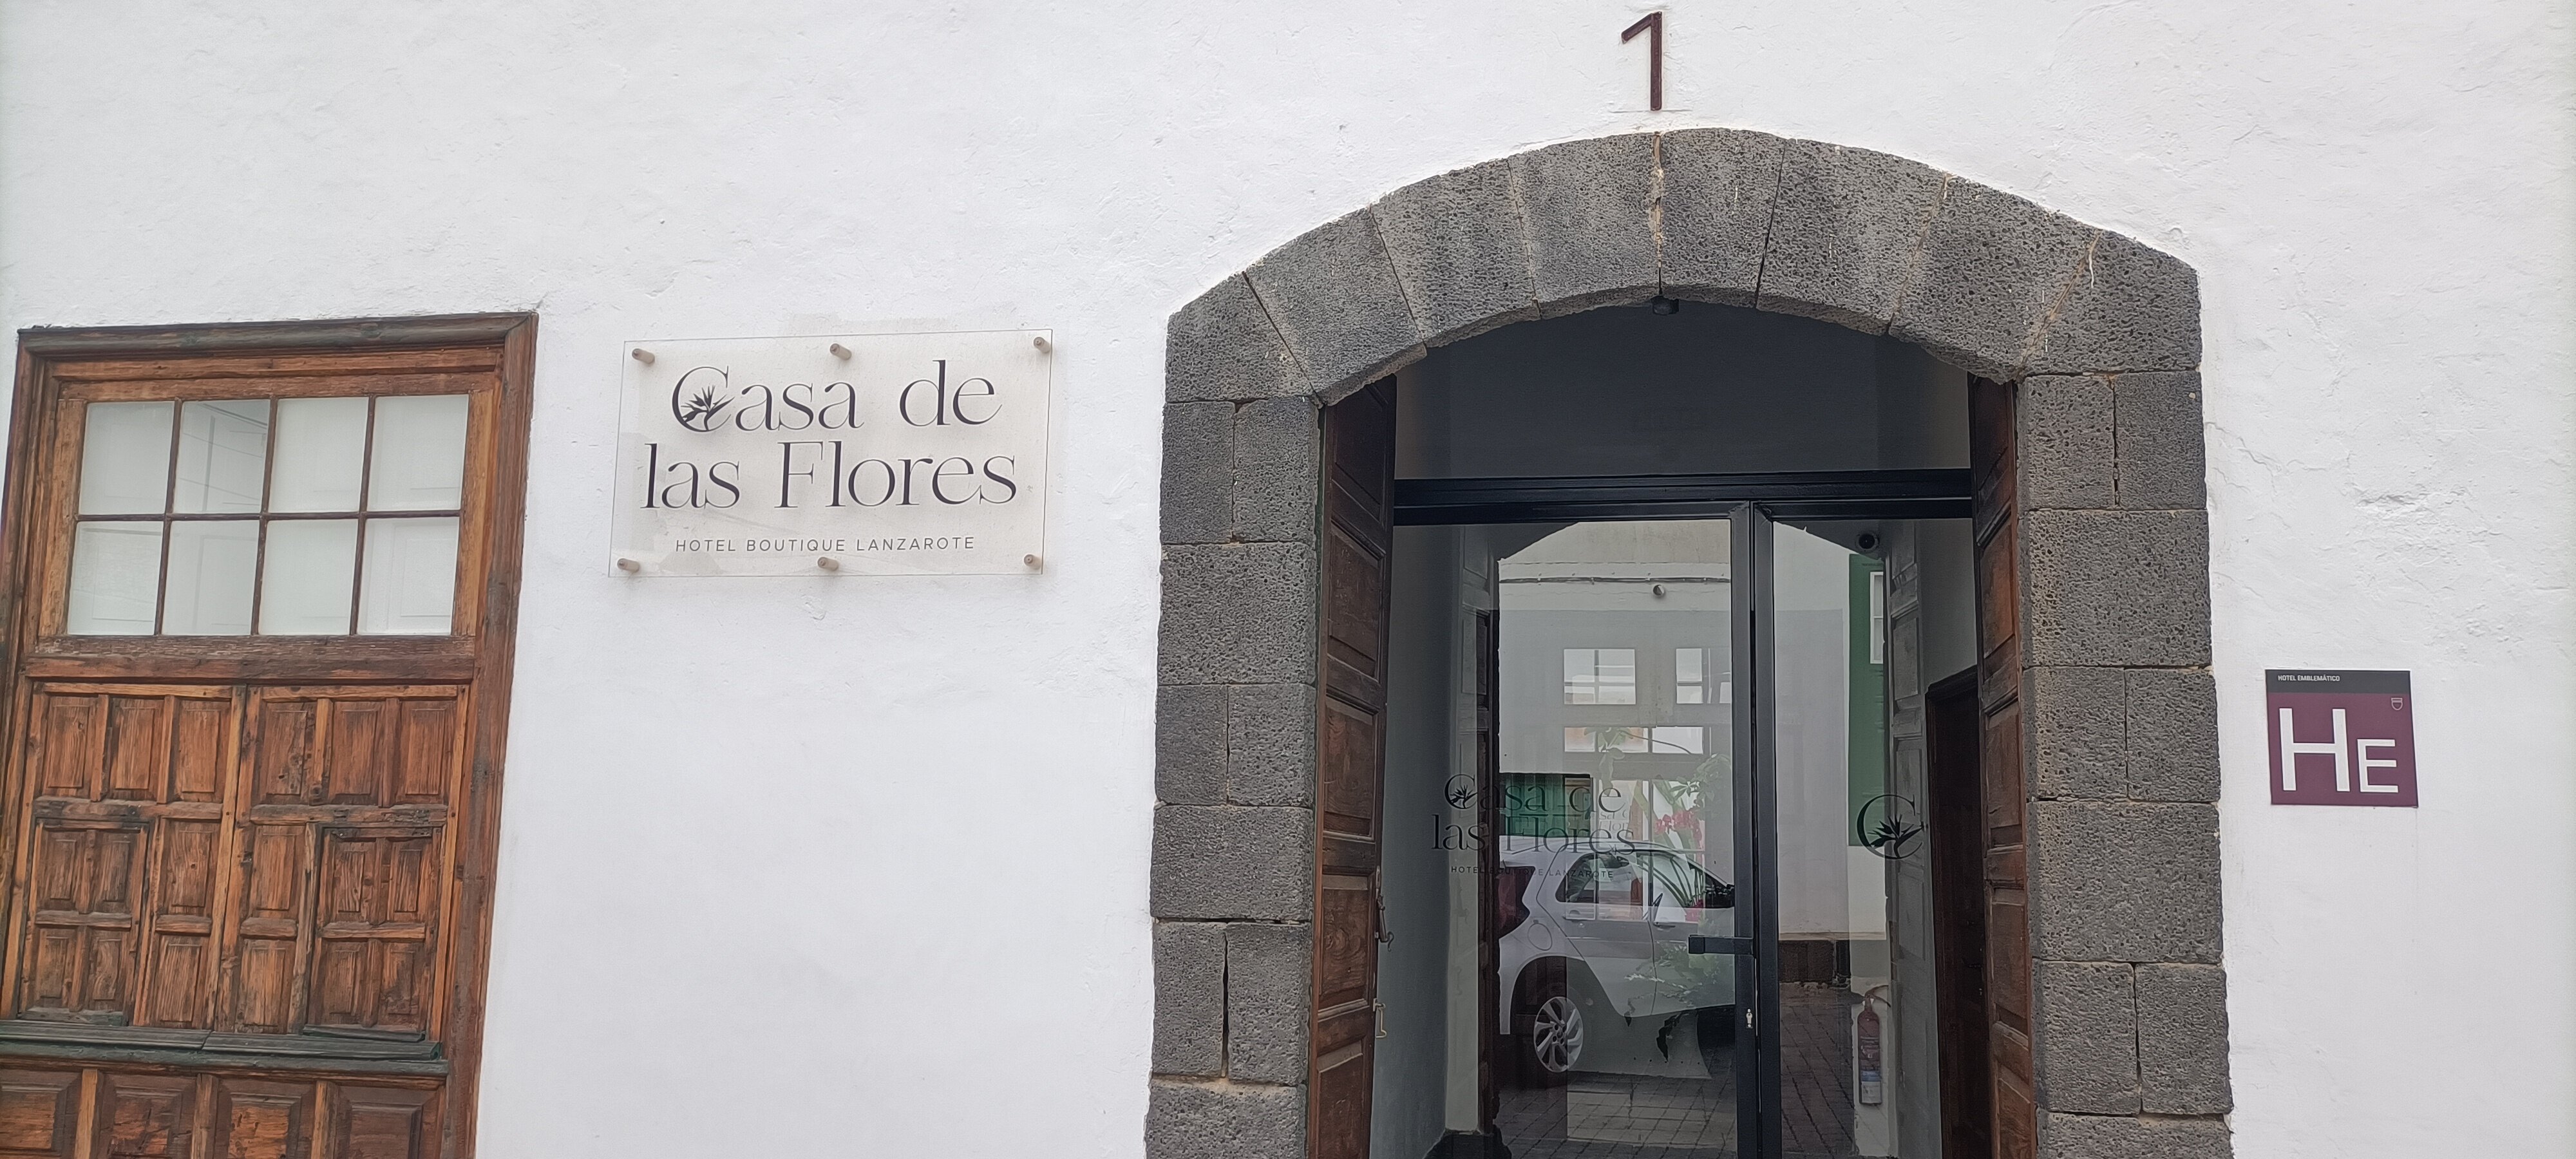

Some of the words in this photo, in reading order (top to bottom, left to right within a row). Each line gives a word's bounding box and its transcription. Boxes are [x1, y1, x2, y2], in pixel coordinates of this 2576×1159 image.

[1621, 11, 1662, 111] 1
[672, 366, 864, 433] Casa
[899, 359, 1003, 428] de
[640, 443, 741, 509] las
[774, 440, 1018, 509] Flores
[676, 539, 736, 552] HOTEL
[746, 538, 846, 552] BOUTIQUE
[857, 536, 975, 552] LANZAROTE
[1444, 774, 1549, 811] Casa
[1569, 777, 1626, 813] de
[1431, 815, 1486, 851] las
[1506, 816, 1635, 855] Flores
[1451, 866, 1485, 874] HOTEL
[1549, 869, 1613, 878] LANZAROTE
